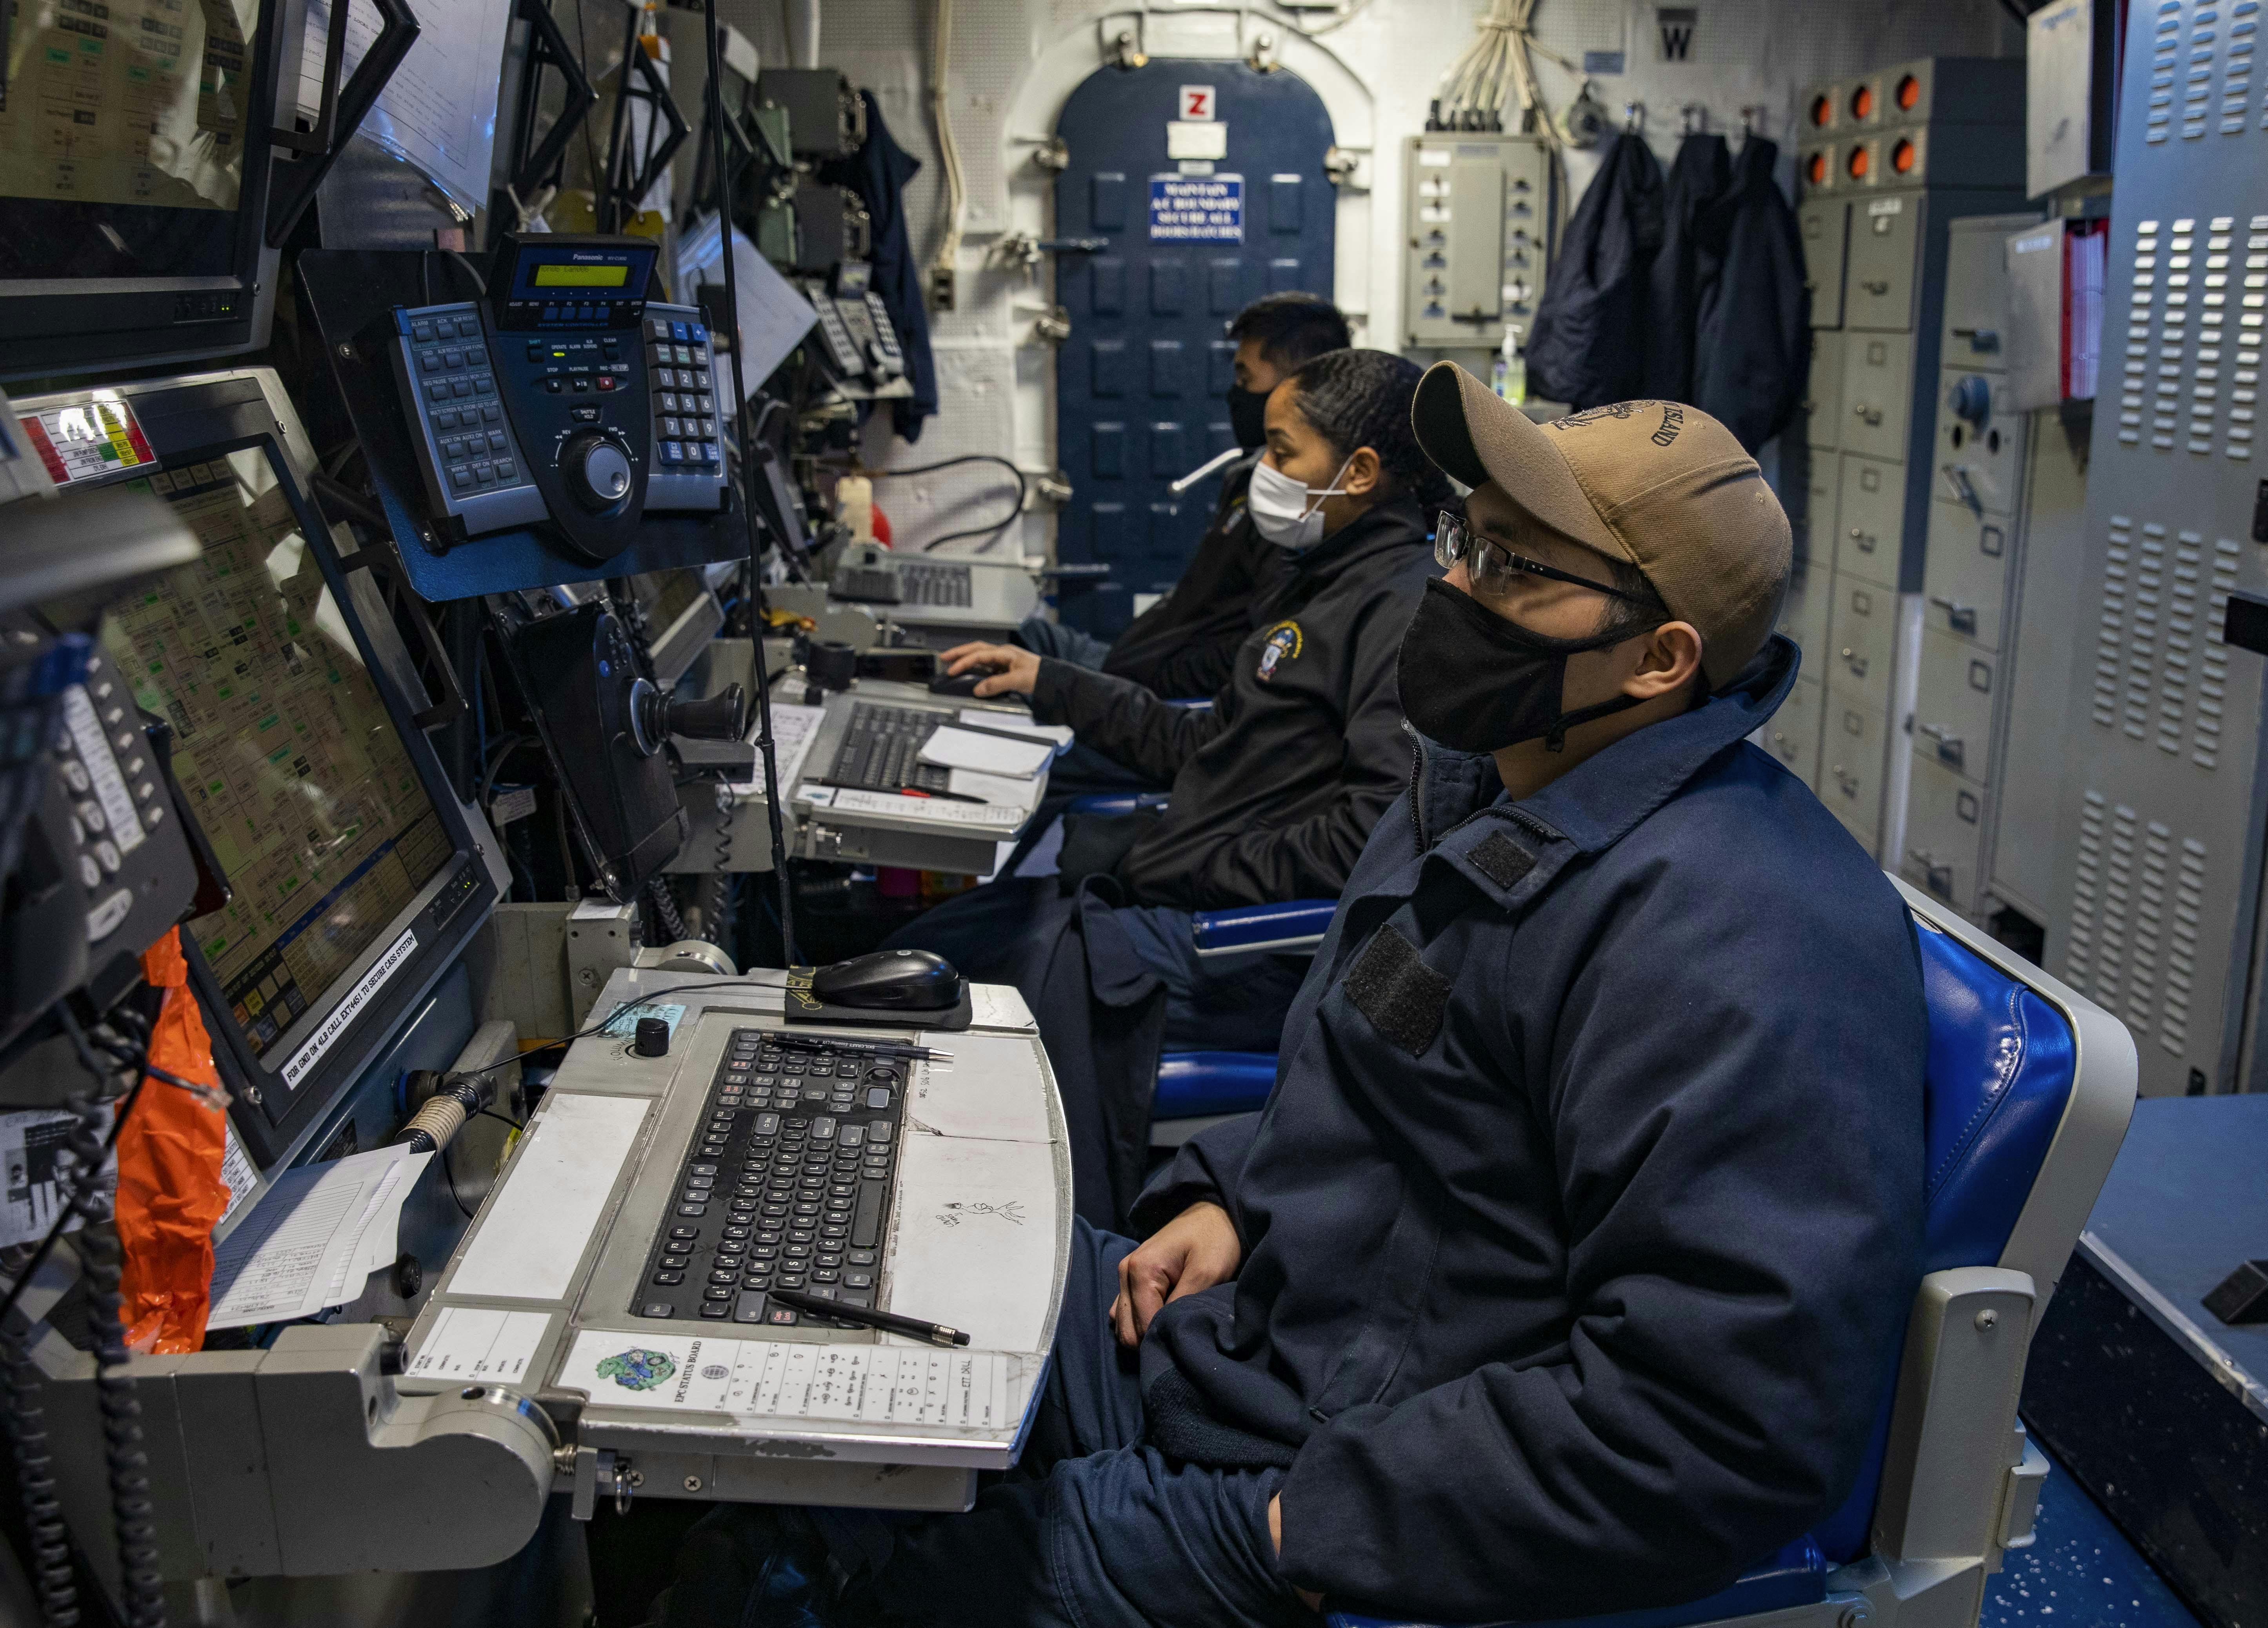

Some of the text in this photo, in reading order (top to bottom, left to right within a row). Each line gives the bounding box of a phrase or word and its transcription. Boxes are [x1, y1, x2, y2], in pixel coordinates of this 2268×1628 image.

[1662, 27, 1693, 60] W
[1188, 94, 1206, 115] Z
[663, 373, 669, 383] 1
[683, 374, 689, 383] 2
[702, 375, 707, 384] 3
[667, 398, 673, 407] 4
[686, 399, 691, 407] 5
[704, 400, 710, 408] 6
[669, 422, 675, 431] 7
[688, 423, 694, 431] 8
[707, 424, 712, 432] 9
[1650, 406, 1684, 446] ISLAND
[691, 446, 697, 456] 0
[286, 934, 415, 1082] FOR GND ON 4LB CALL EXT4451 TO SECURE CASS SYSTEM
[610, 1039, 631, 1060] VOLUME
[936, 1215, 954, 1228] COVID
[945, 1214, 960, 1225] VIRUS
[674, 1341, 702, 1403] EPC STATUS BOARD
[961, 1360, 971, 1388] ETT DRILL
